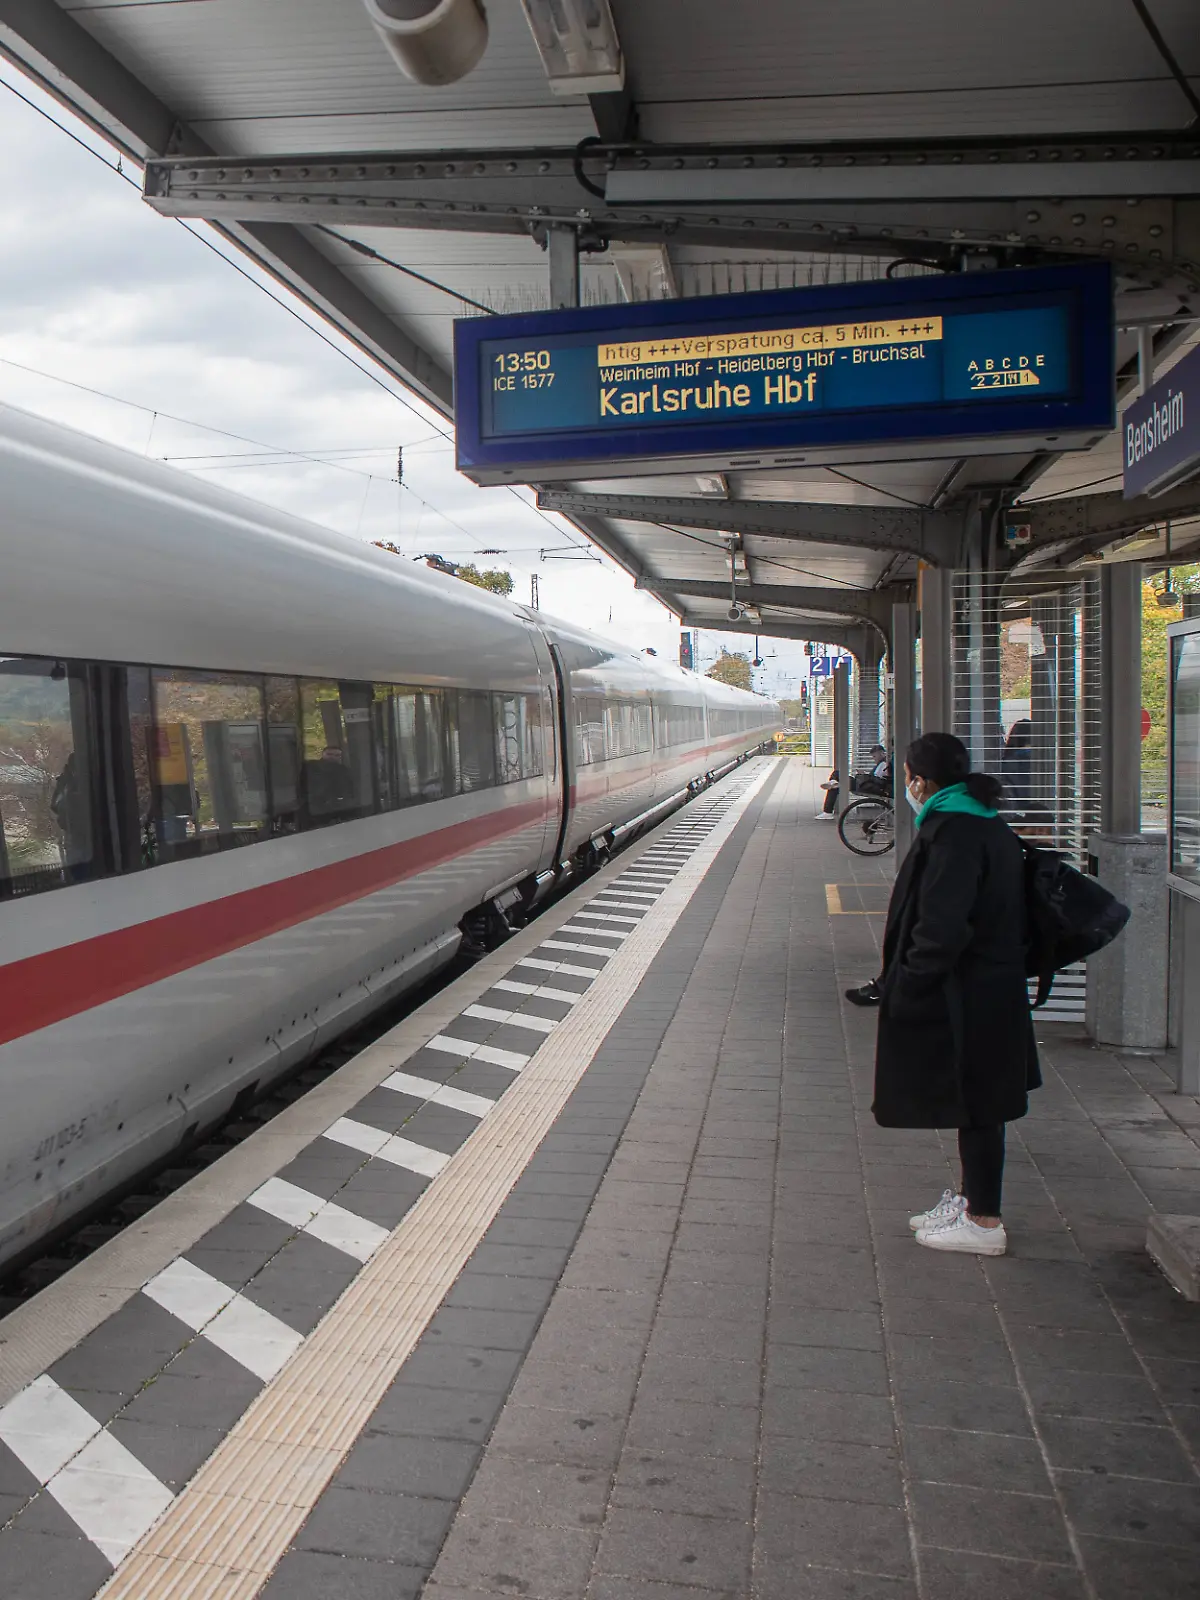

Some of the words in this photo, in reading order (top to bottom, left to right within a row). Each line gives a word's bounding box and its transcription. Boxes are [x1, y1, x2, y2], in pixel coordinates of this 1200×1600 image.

[605, 344, 641, 362] htig
[801, 331, 829, 344] ca.
[836, 327, 845, 342] 5
[853, 324, 890, 340] Min.
[897, 322, 934, 336] +++
[494, 350, 551, 373] 13:50
[600, 366, 671, 383] Weinheim
[674, 361, 701, 377] Hbf
[718, 355, 802, 374] Heidelberg
[806, 350, 835, 367] Hbf
[852, 343, 926, 364] Bruchsal
[967, 360, 979, 372] A
[985, 358, 994, 370] B
[1002, 357, 1011, 369] C
[1019, 355, 1029, 367] D
[1035, 354, 1045, 366] E
[493, 376, 516, 391] ICE
[520, 373, 555, 389] 1577
[976, 375, 985, 387] 2
[992, 374, 1001, 385] 2
[600, 381, 751, 416] Karlsruhe
[764, 372, 817, 405] Hbf
[1127, 389, 1184, 468] Bensheim
[812, 657, 823, 672] 2
